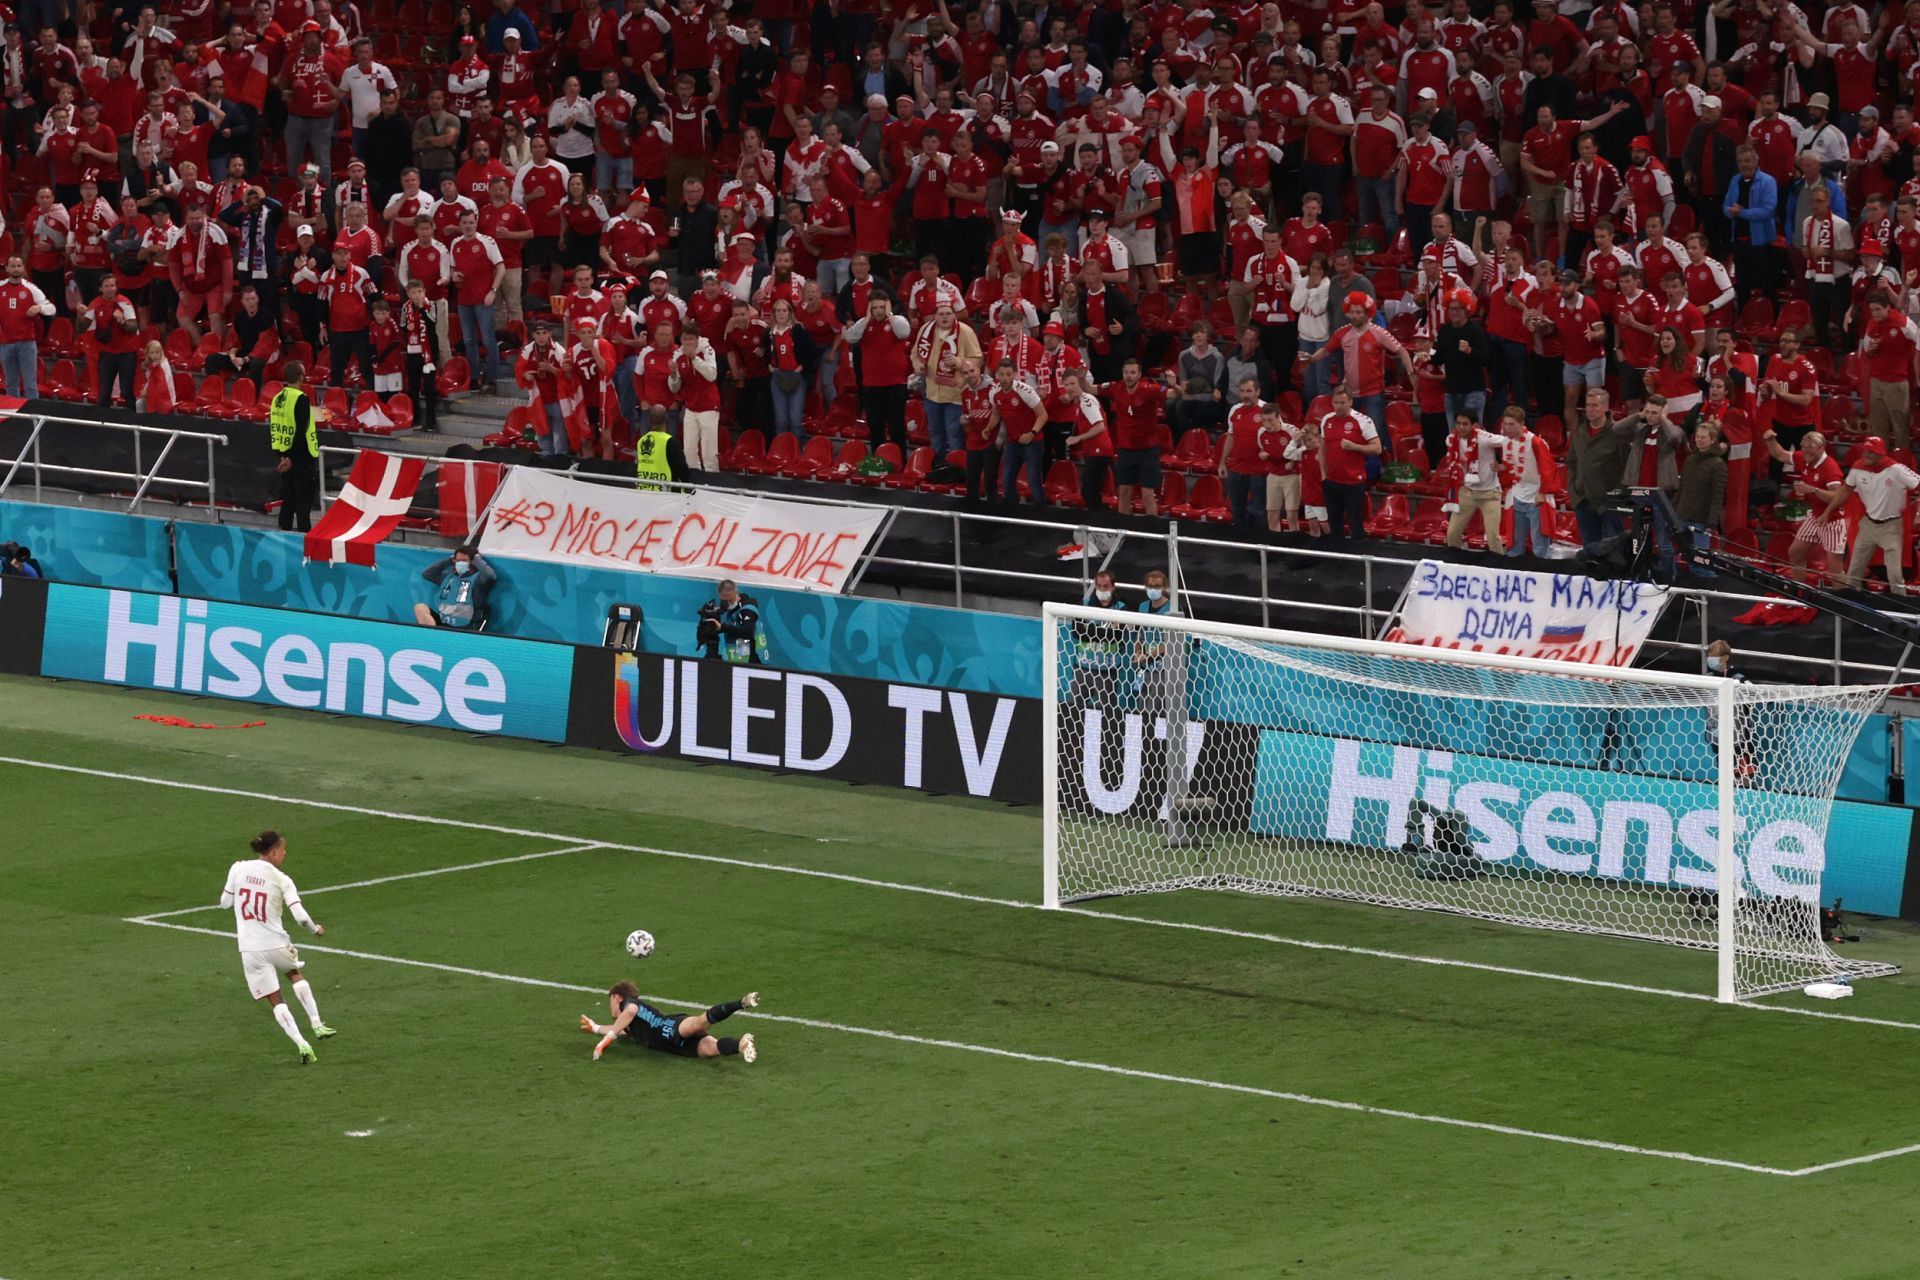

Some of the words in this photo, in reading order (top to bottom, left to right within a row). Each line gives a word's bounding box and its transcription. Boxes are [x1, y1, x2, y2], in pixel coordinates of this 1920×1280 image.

[104, 589, 506, 732] Hisense
[1457, 607, 1533, 641] ДОМА
[614, 652, 852, 772] ULED
[888, 684, 1017, 797] TV
[1325, 739, 1825, 901] Hisense
[239, 888, 268, 924] 20
